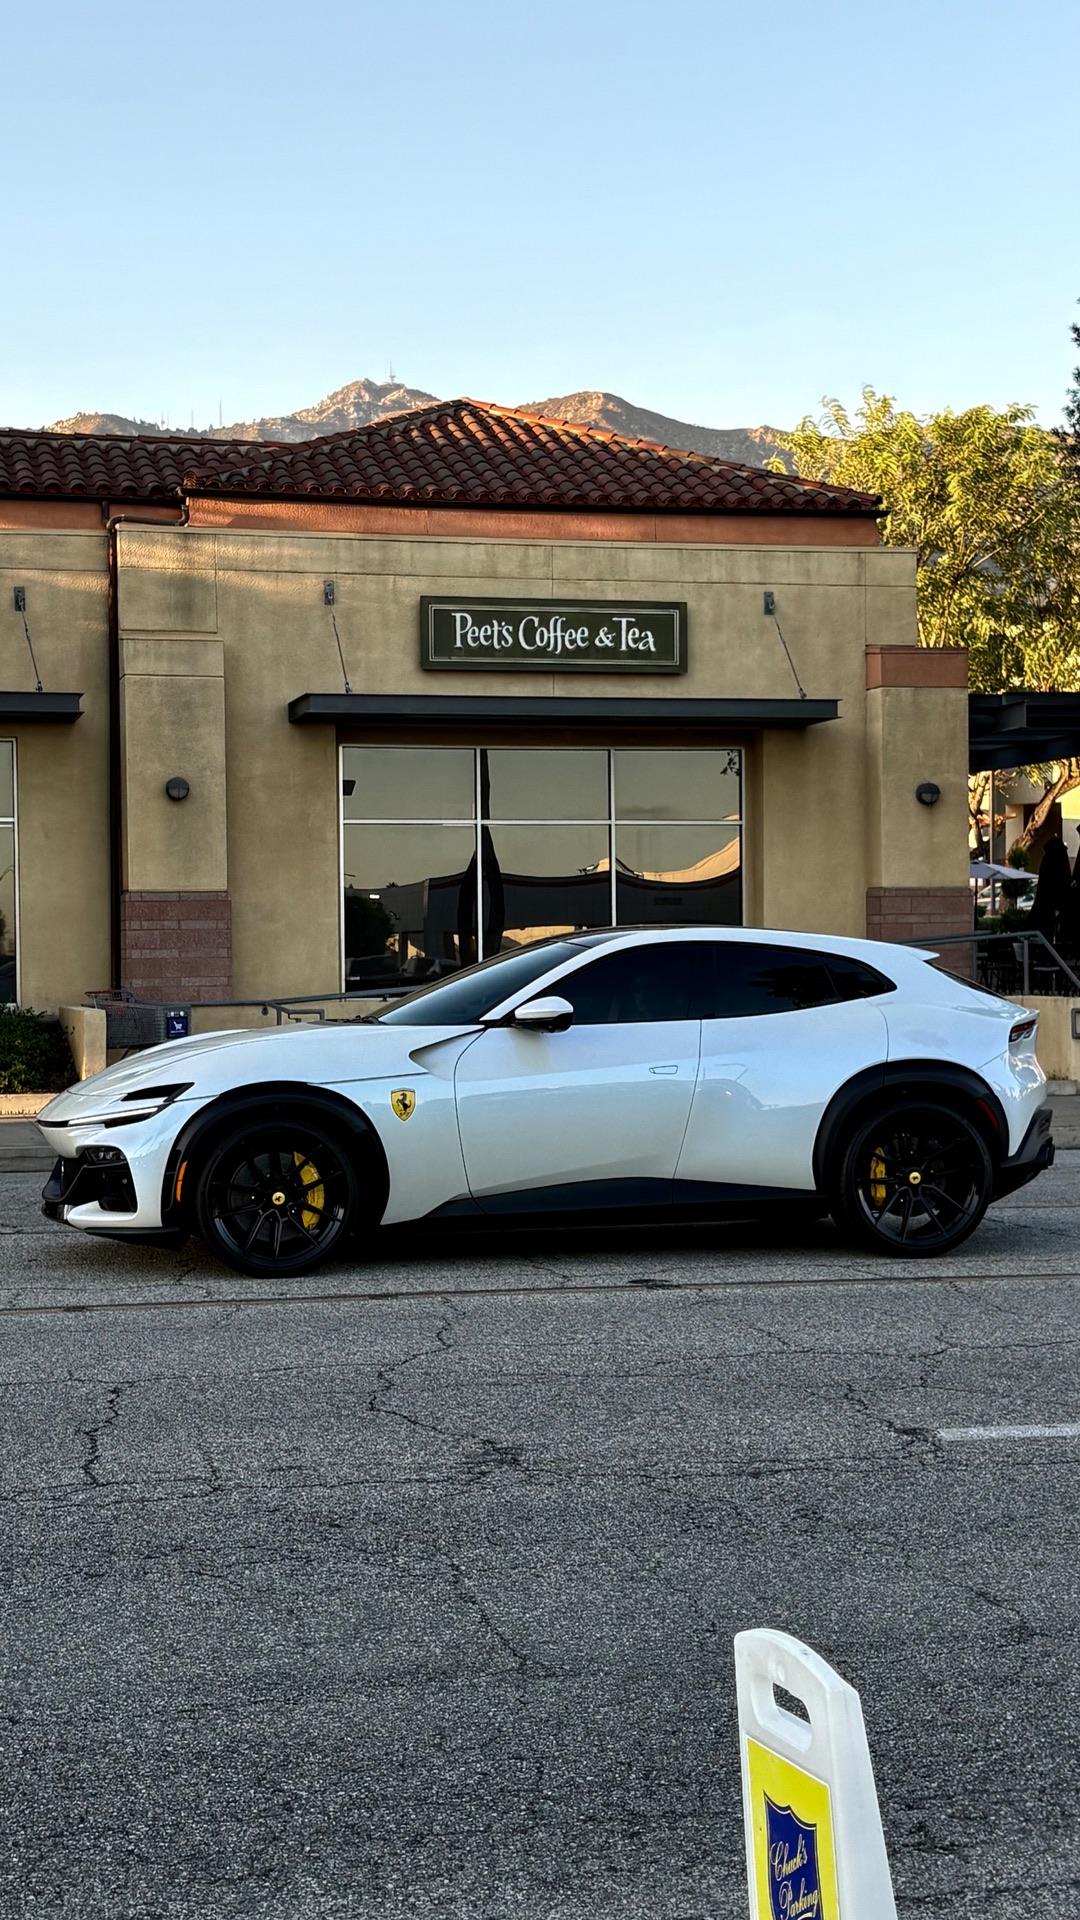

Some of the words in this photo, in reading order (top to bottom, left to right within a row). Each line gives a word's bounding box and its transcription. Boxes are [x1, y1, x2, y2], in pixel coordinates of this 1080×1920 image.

[451, 612, 514, 650] Peet's
[518, 615, 590, 655] Coffee
[594, 626, 616, 648] &
[612, 617, 657, 652] Tea
[769, 1833, 808, 1881] Chuck's
[778, 1877, 818, 1920] Parking
